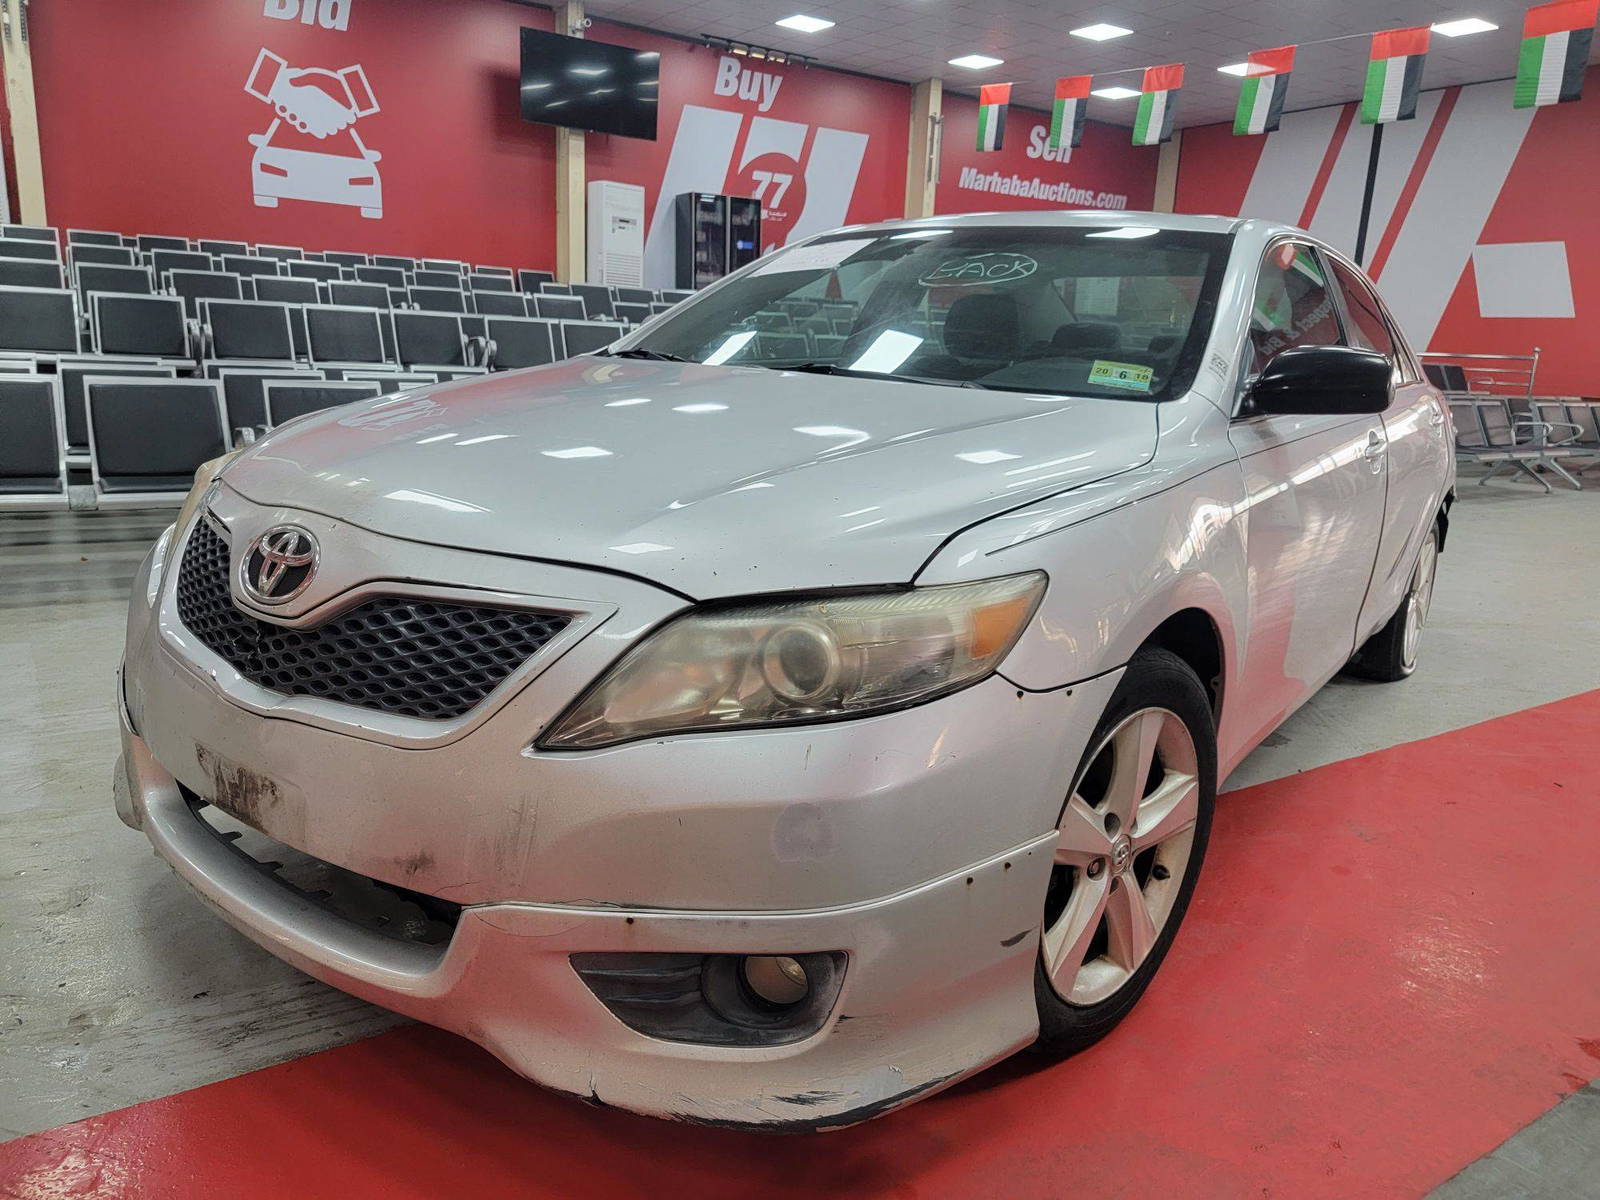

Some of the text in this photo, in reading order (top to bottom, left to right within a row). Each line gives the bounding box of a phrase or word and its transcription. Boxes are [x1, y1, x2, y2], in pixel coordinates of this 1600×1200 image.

[714, 56, 783, 112] Buy
[752, 170, 793, 209] 77
[958, 167, 1128, 210] MarhabaAuctions.com
[1095, 367, 1109, 375] 20
[1119, 370, 1128, 380] 6
